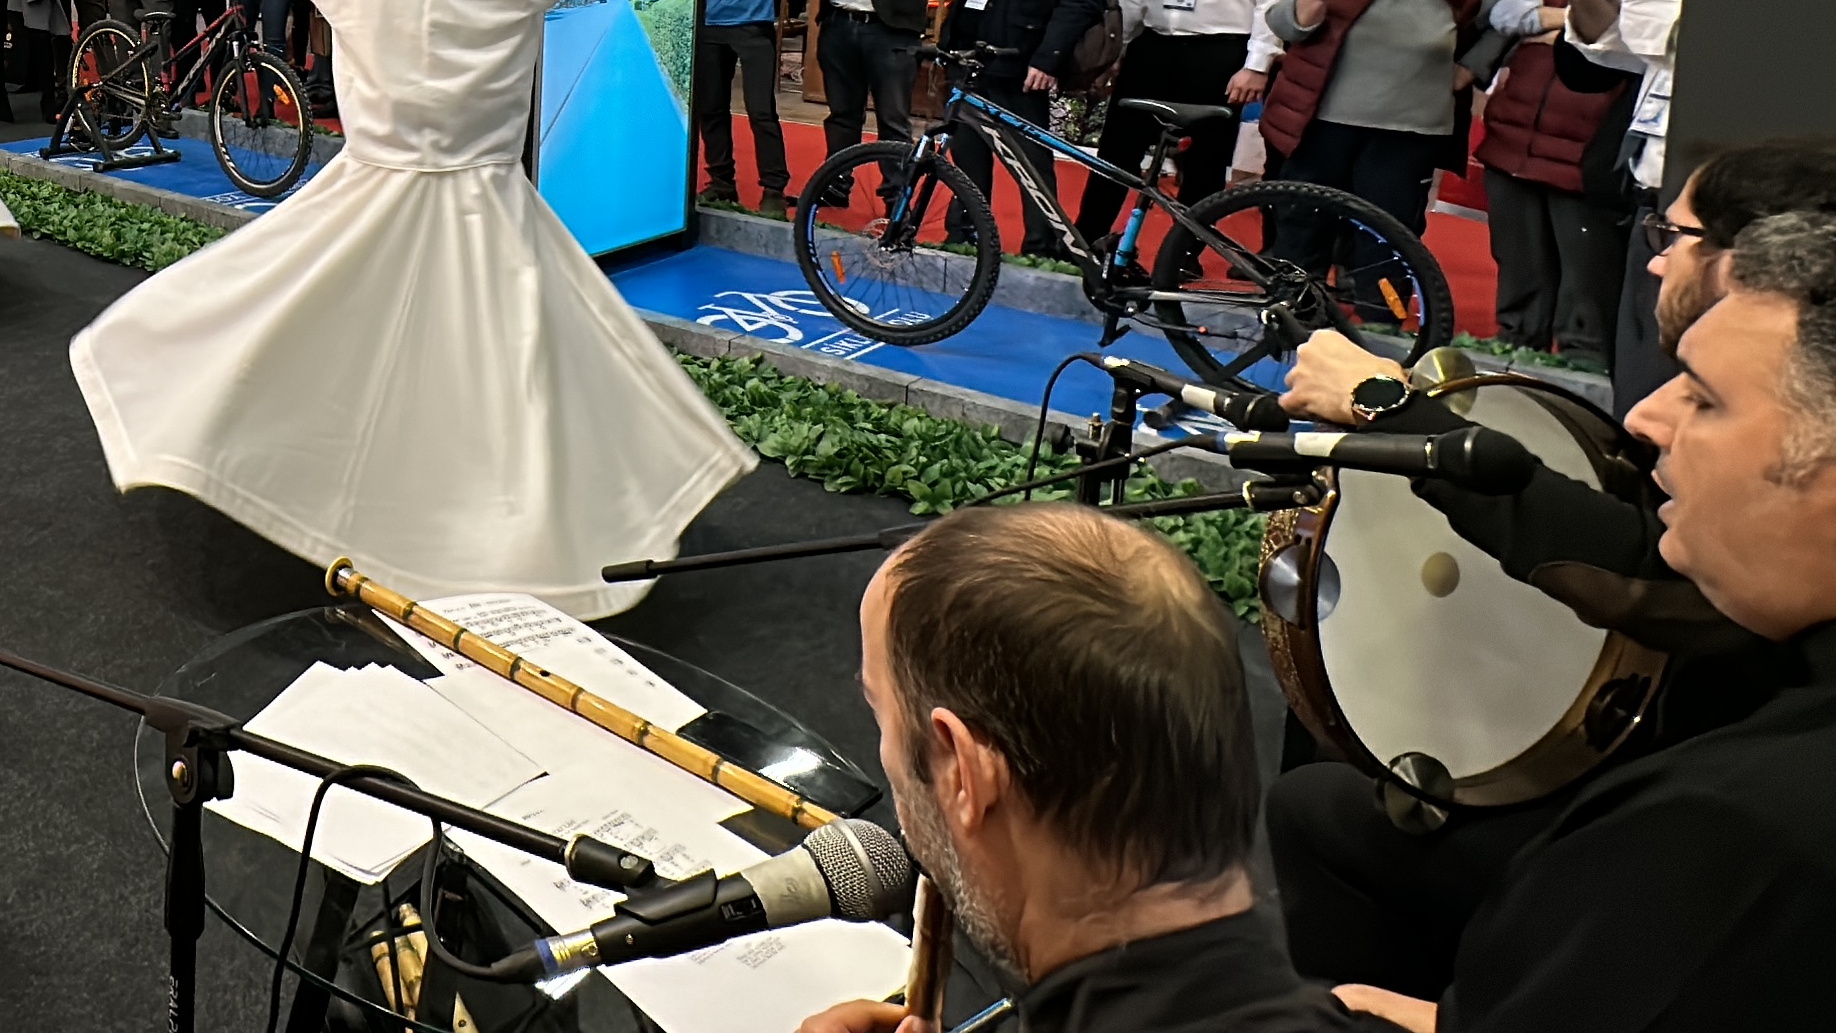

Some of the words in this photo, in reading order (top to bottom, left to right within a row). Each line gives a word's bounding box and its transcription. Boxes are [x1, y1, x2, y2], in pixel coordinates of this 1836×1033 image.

[980, 124, 1089, 259] KRON
[820, 334, 872, 355] SİKL
[168, 975, 179, 1033] ERALP
